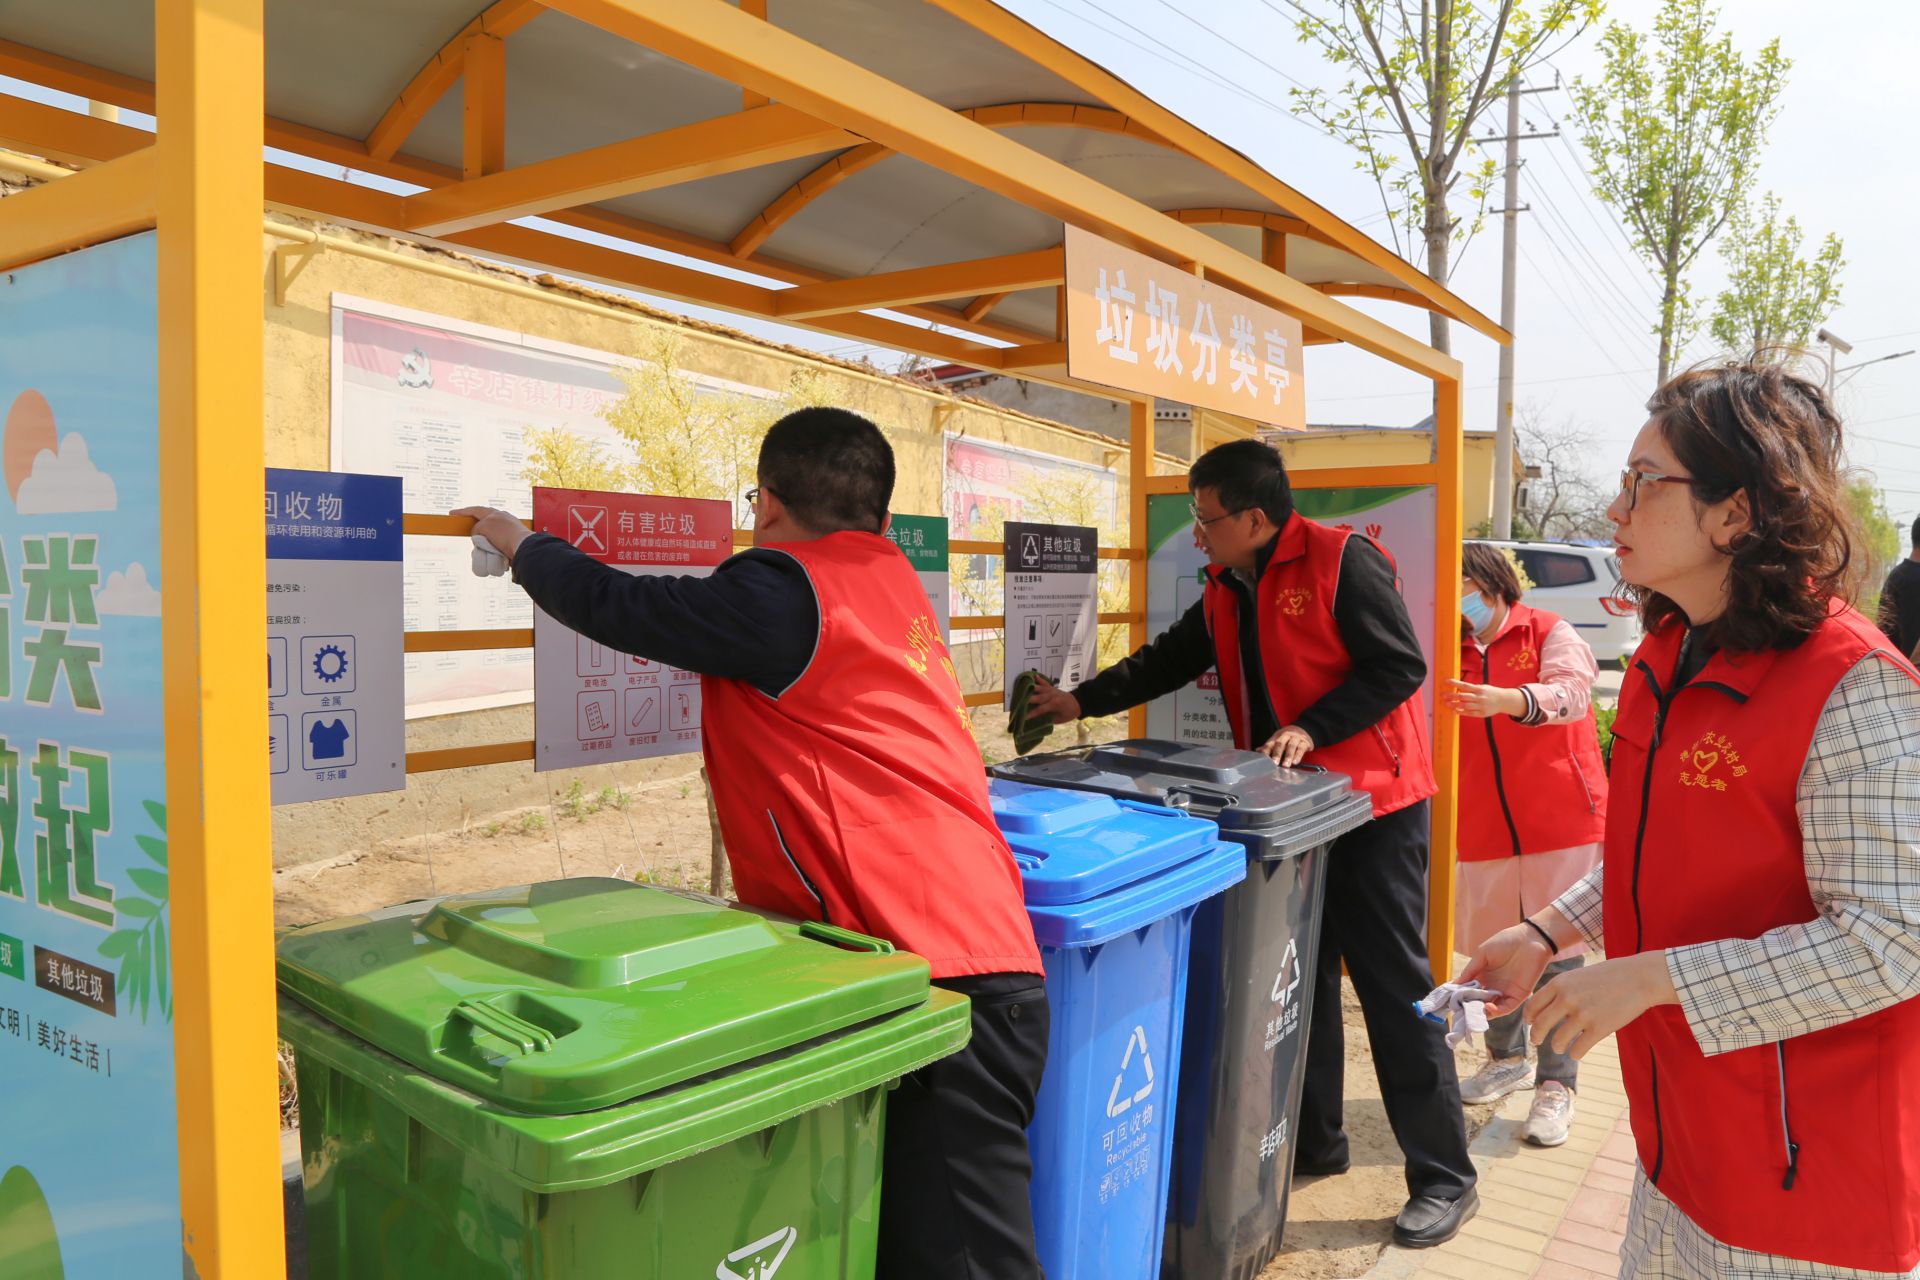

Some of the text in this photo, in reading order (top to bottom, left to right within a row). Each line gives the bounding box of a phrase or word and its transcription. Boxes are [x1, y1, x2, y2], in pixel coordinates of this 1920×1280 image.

[1095, 266, 1290, 405] 垃圾分类亭
[617, 510, 696, 536] 有害垃圾
[1043, 536, 1083, 553] 其他垃圾
[0, 533, 103, 713] 类
[628, 675, 658, 685] 电子产品
[321, 696, 342, 707] 金属
[47, 957, 105, 1003] 其他垃圾
[1102, 1103, 1153, 1152] 可回收物
